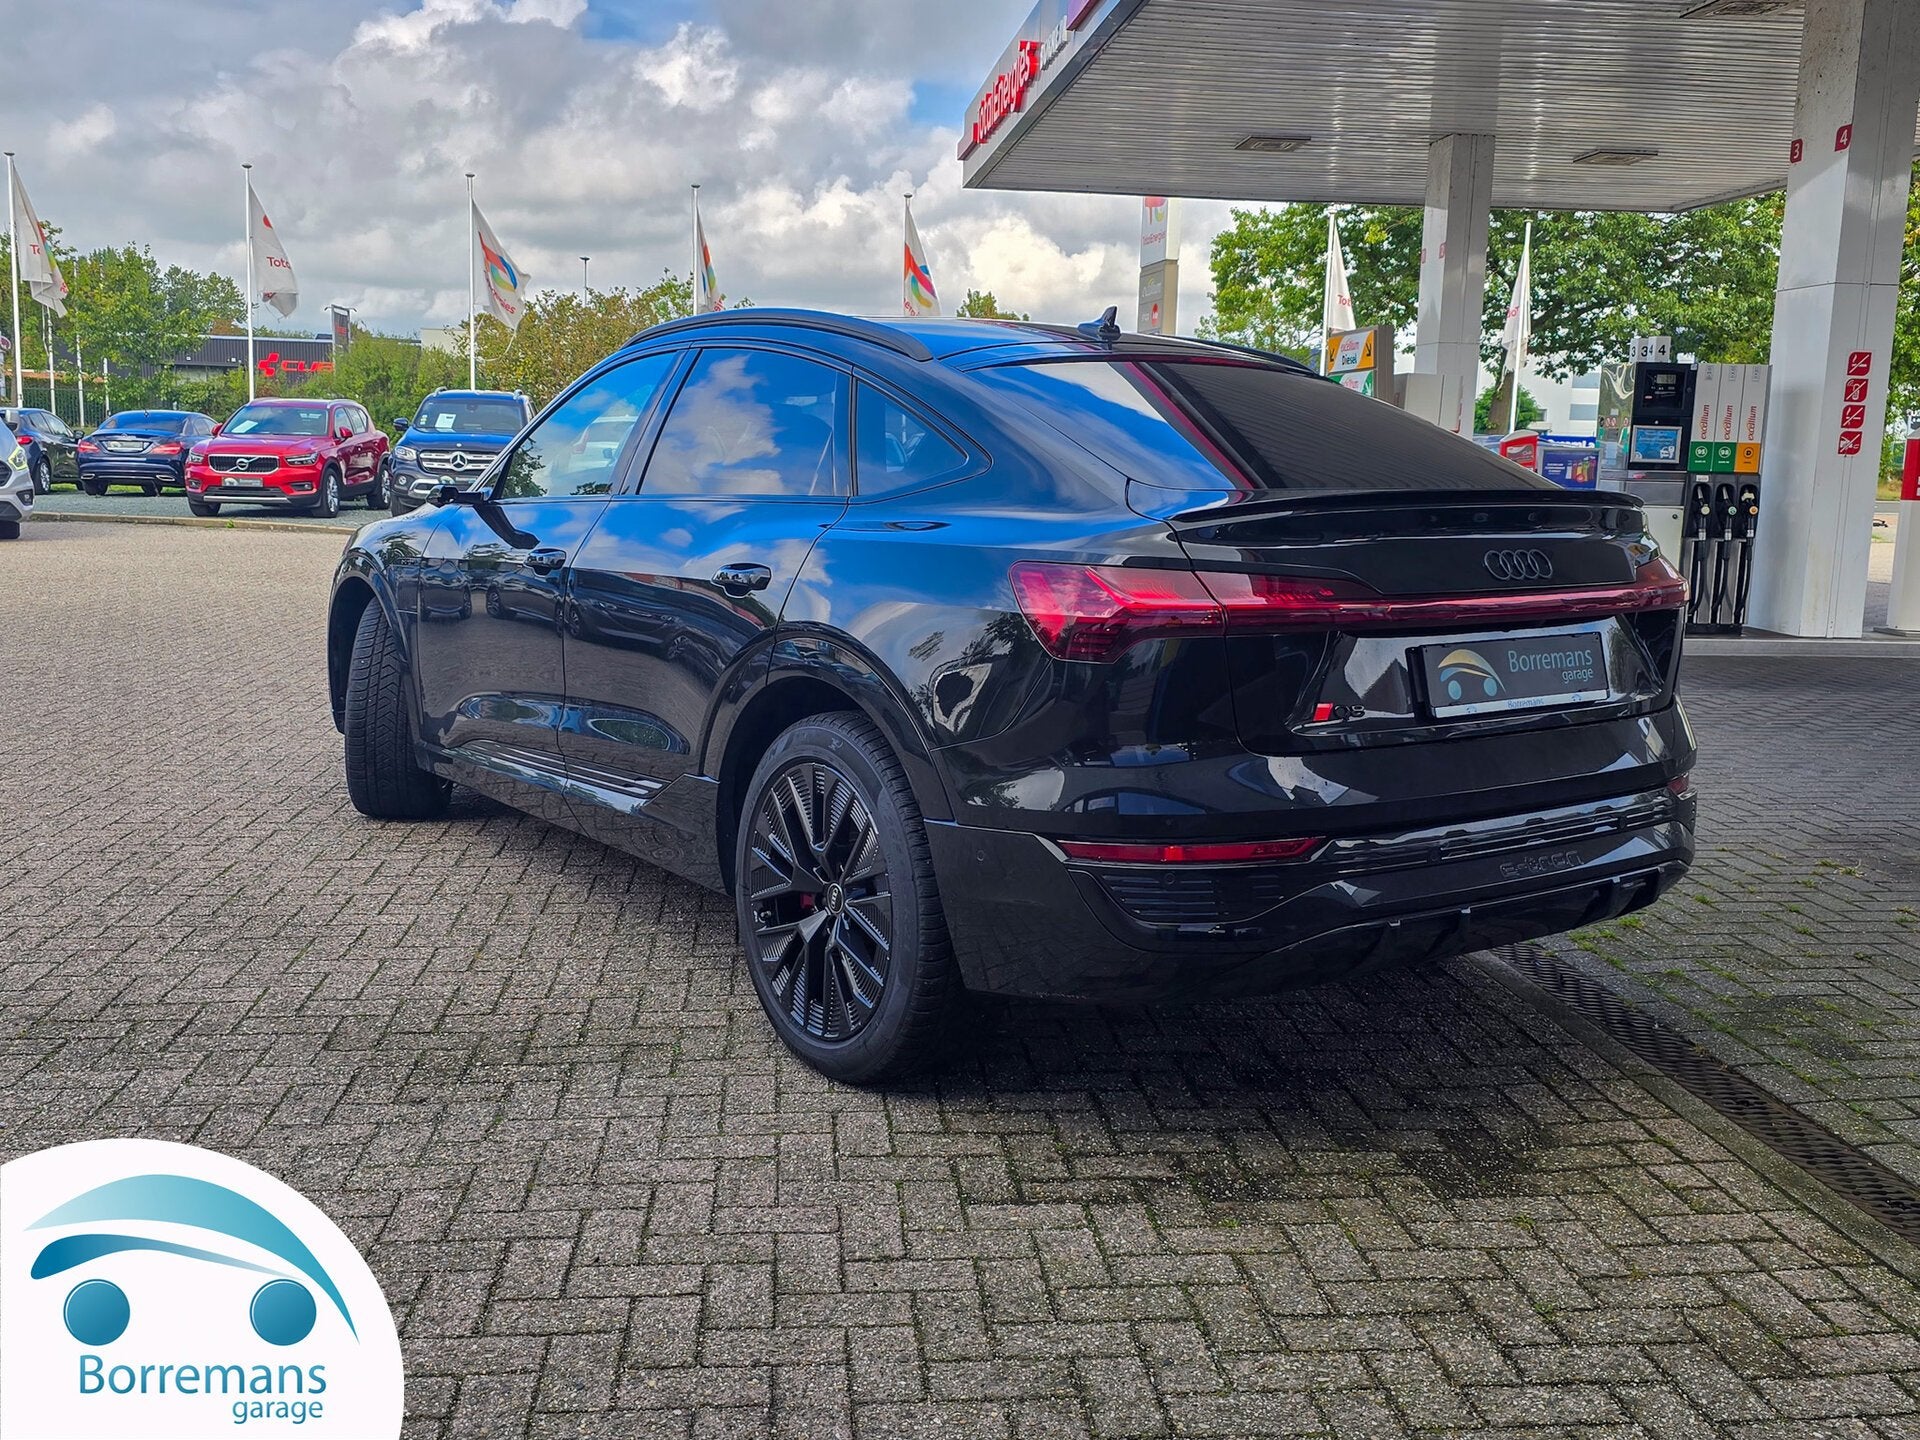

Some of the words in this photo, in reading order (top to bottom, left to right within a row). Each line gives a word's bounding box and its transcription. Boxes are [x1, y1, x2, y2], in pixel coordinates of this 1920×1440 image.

[1840, 129, 1848, 145] 4
[1793, 143, 1800, 159] 3
[1641, 346, 1648, 357] 3
[1658, 345, 1666, 355] 4
[1508, 649, 1593, 673] Borremans
[1562, 667, 1594, 684] garage
